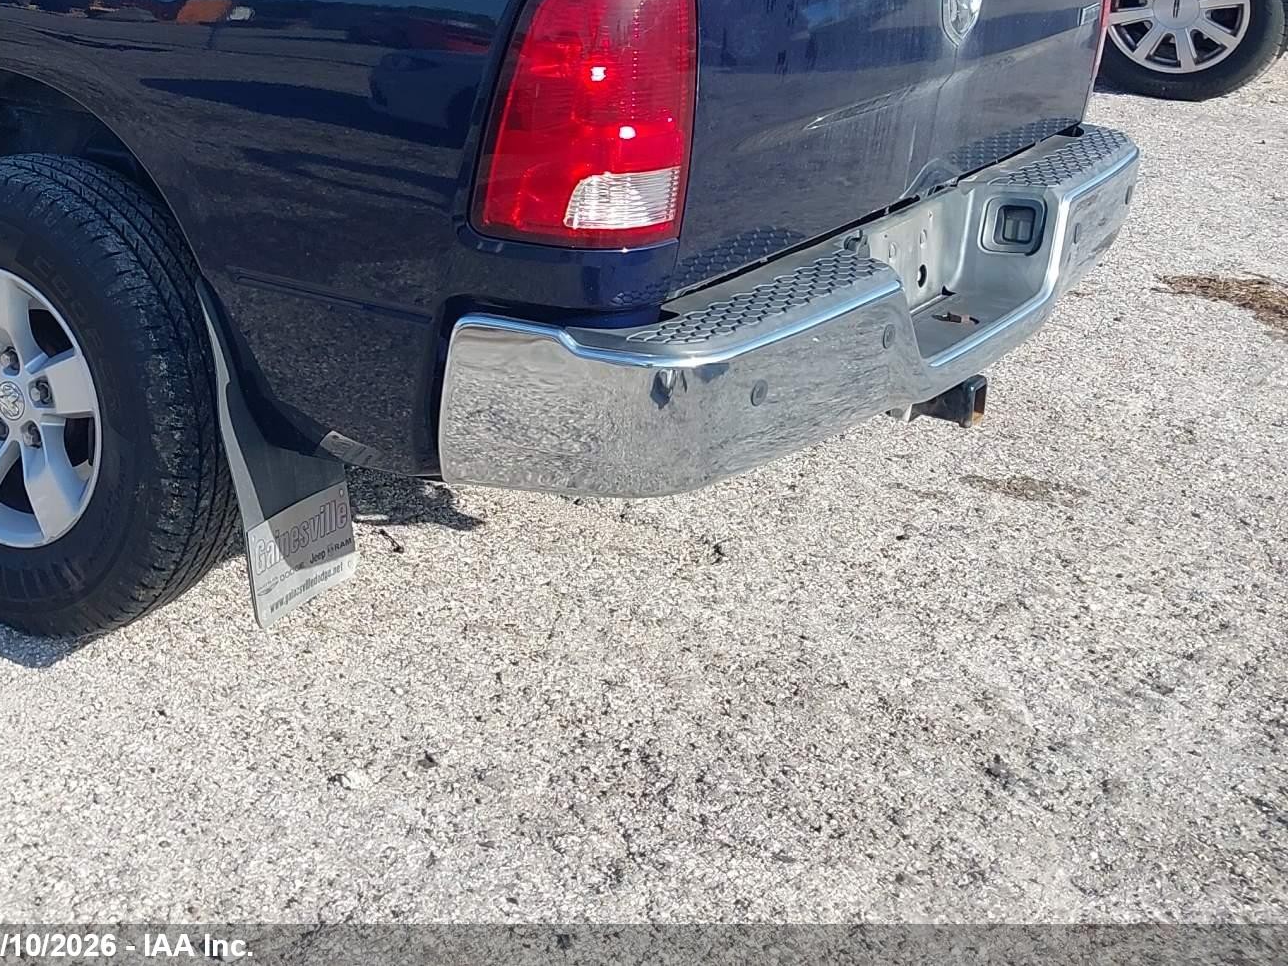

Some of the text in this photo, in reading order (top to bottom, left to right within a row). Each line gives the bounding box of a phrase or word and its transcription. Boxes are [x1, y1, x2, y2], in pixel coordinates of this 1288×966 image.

[255, 500, 348, 575] Gainesville
[309, 549, 326, 564] Jeep
[334, 537, 352, 550] RAM
